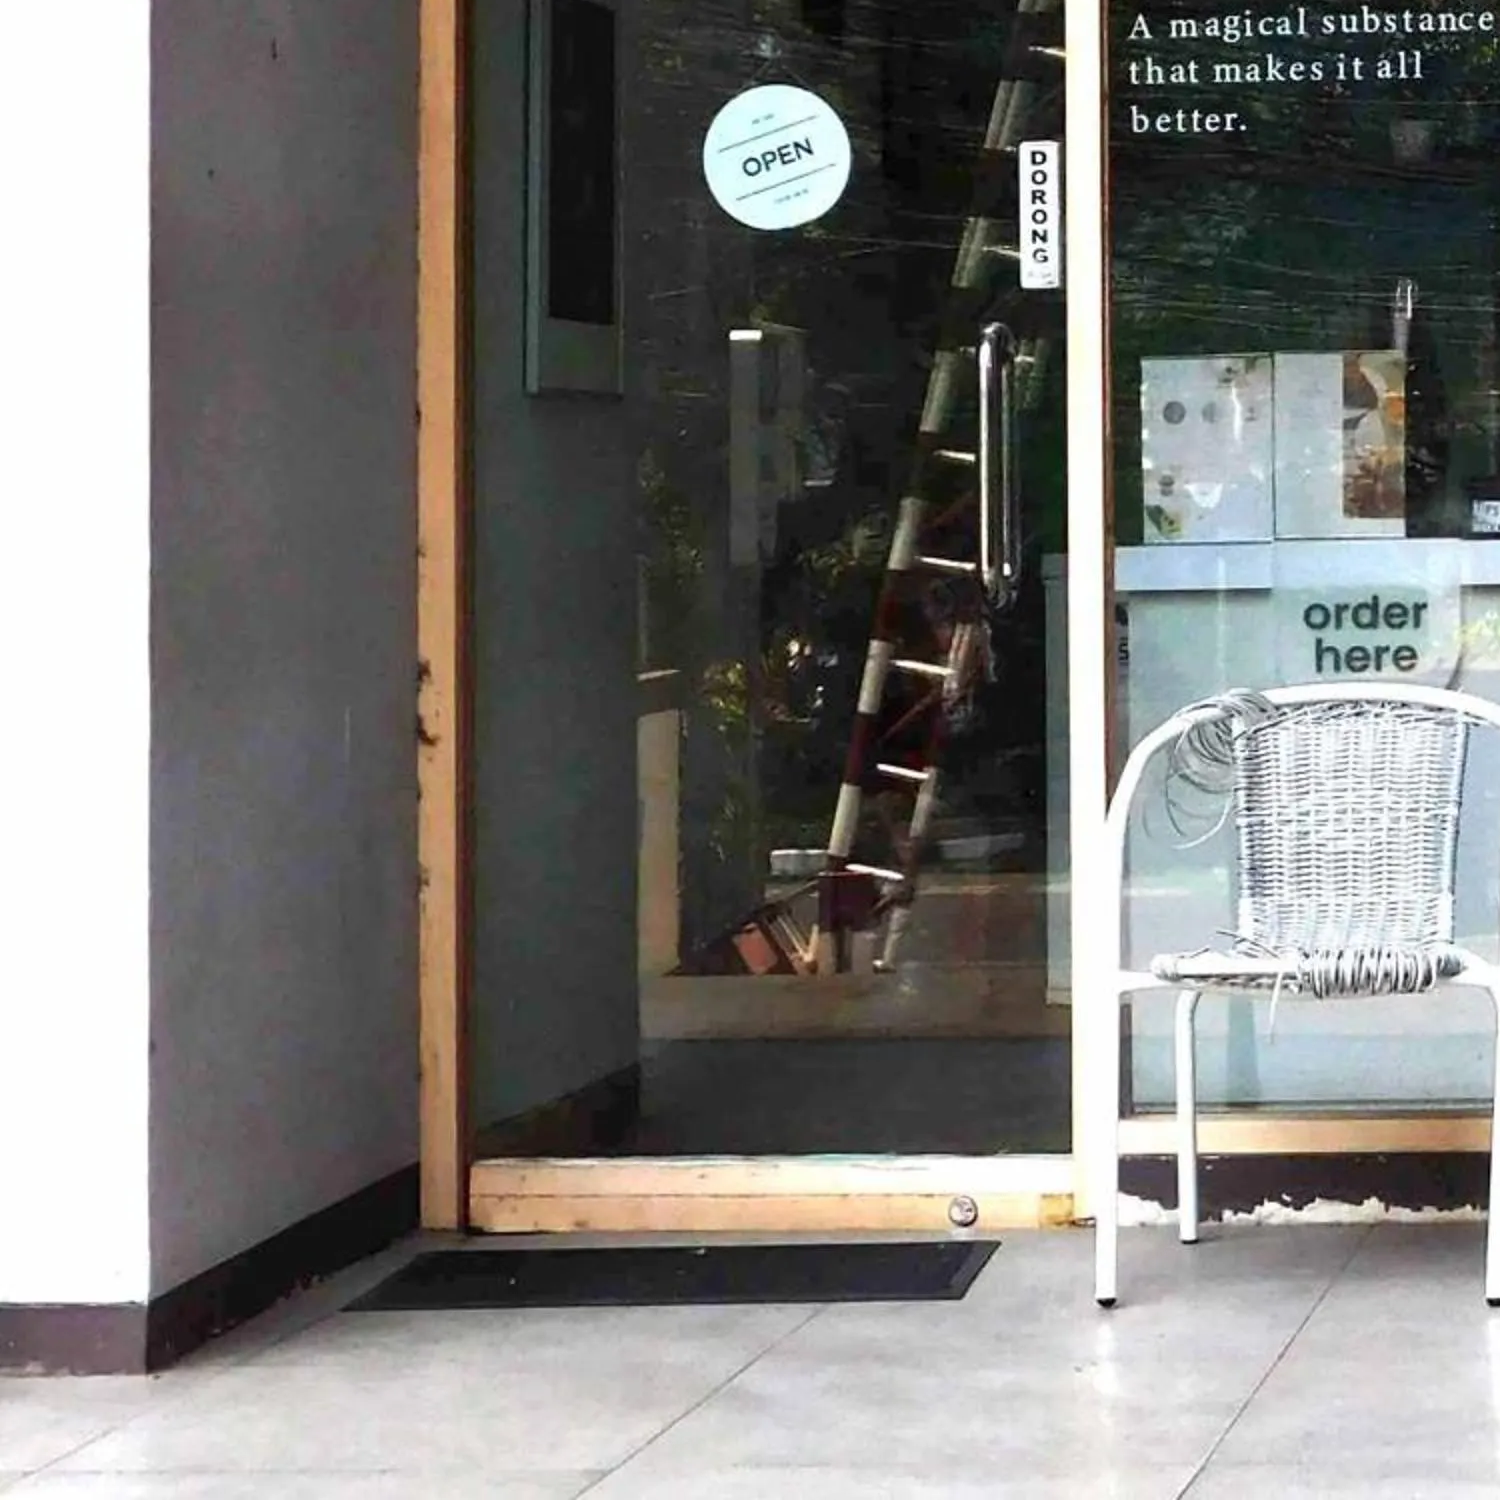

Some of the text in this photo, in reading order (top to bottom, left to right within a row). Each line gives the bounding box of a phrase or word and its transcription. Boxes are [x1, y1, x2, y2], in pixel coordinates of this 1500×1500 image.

[1127, 5, 1496, 43] A magical substance
[1129, 50, 1425, 86] that makes it all
[1130, 104, 1248, 134] better.
[741, 136, 816, 178] OPEN
[1029, 150, 1049, 264] DORONG
[1303, 594, 1429, 631] order
[1314, 638, 1419, 674] here
